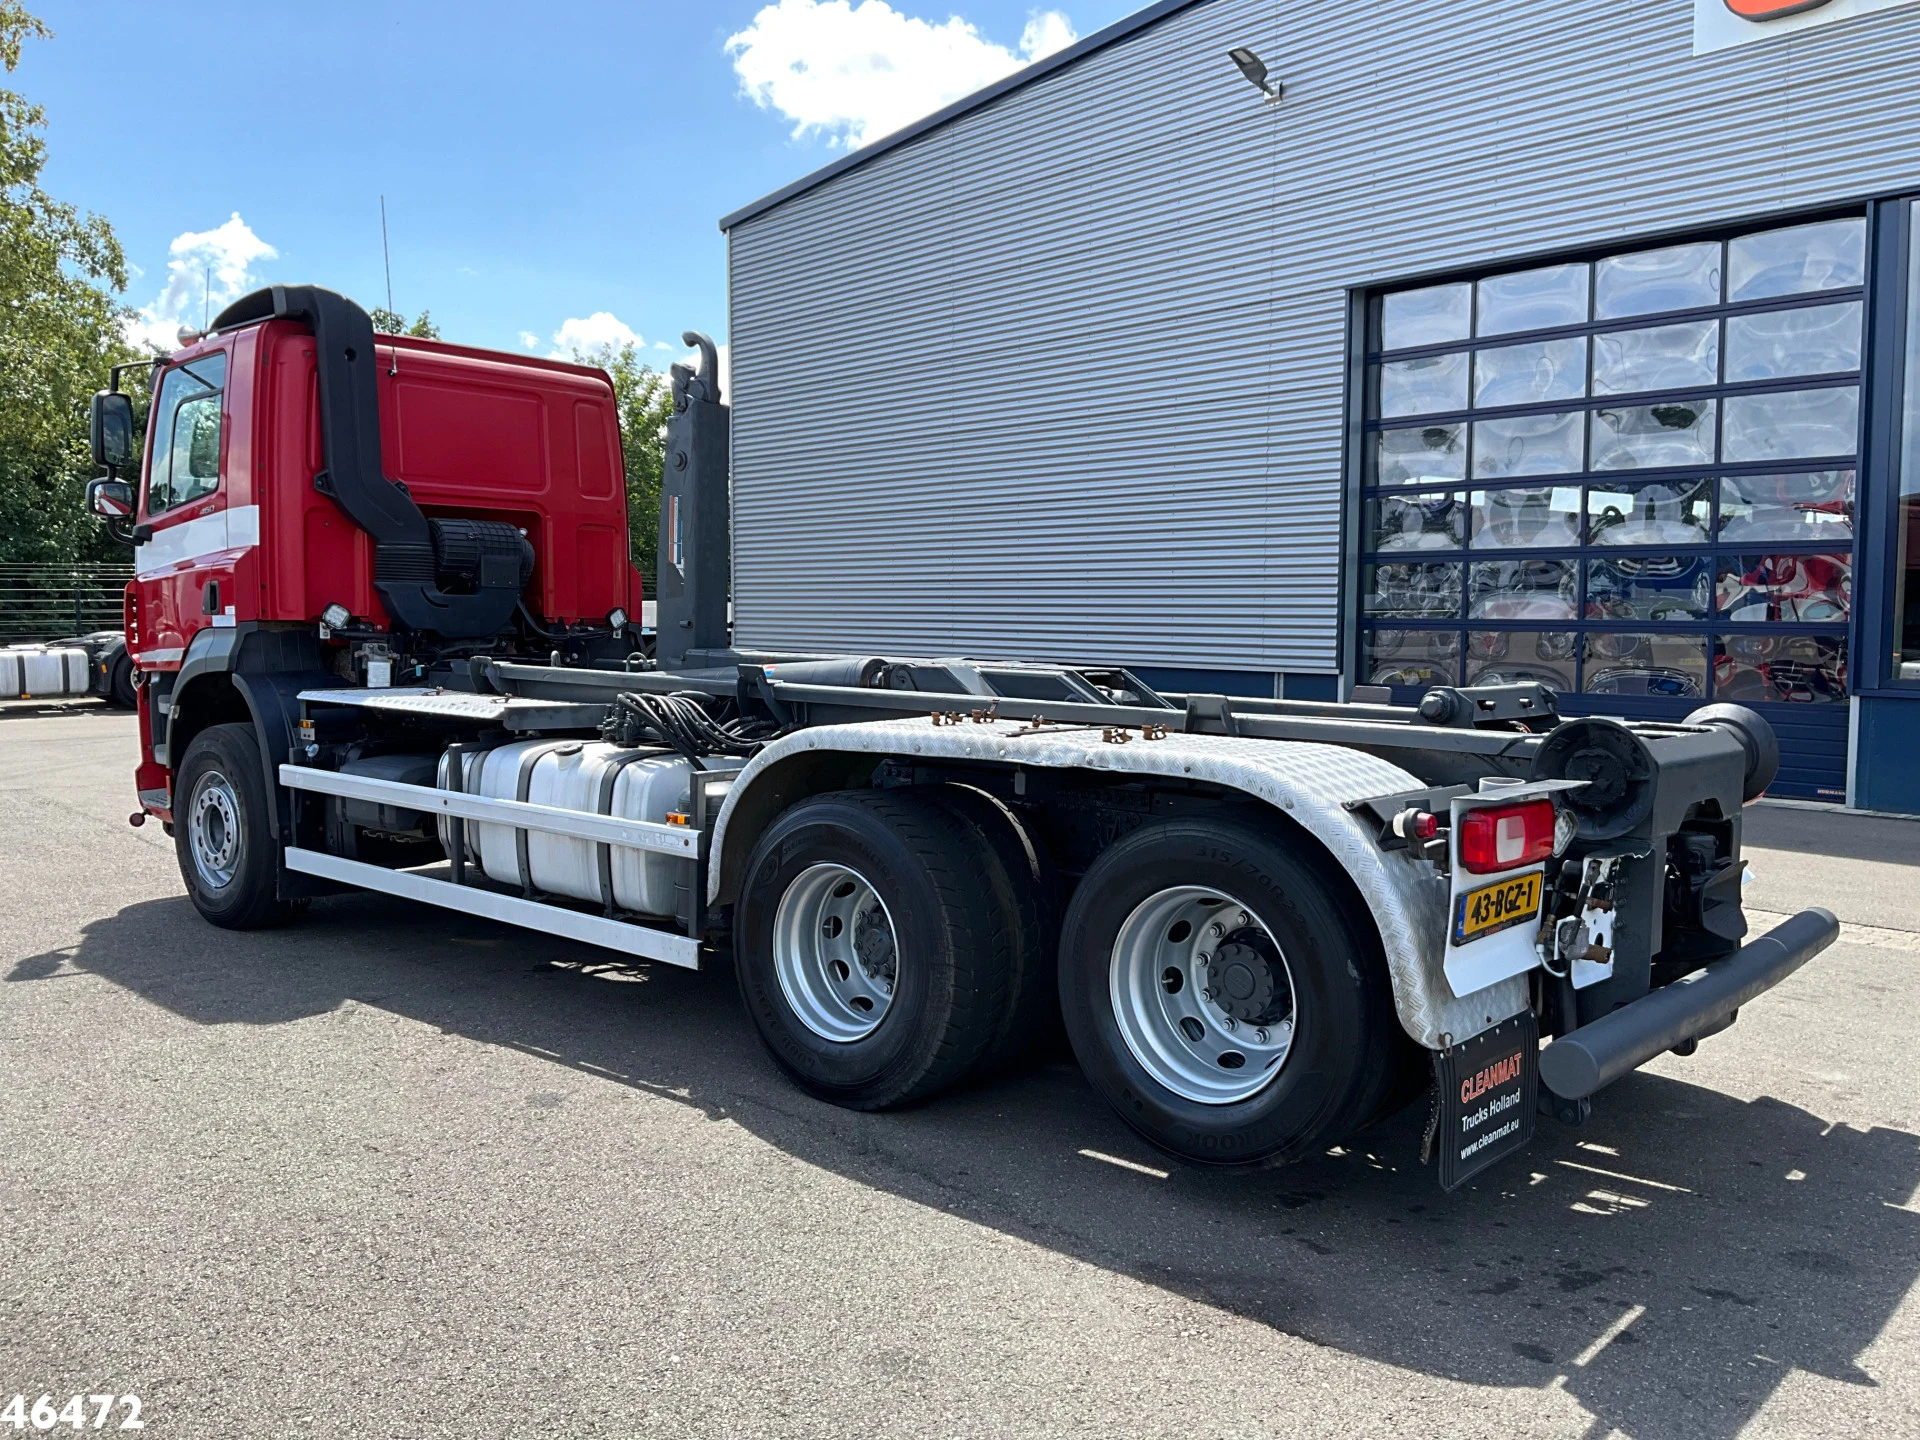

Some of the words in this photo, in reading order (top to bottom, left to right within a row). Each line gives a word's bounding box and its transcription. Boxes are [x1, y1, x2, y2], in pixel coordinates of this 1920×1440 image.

[1470, 880, 1533, 925] 43-BGZ-1
[1461, 1052, 1522, 1104] CLEANMAT
[1462, 1106, 1488, 1132] Trucks
[1489, 1088, 1520, 1116] Holland
[1460, 1118, 1519, 1160] www.cleanmat.eu
